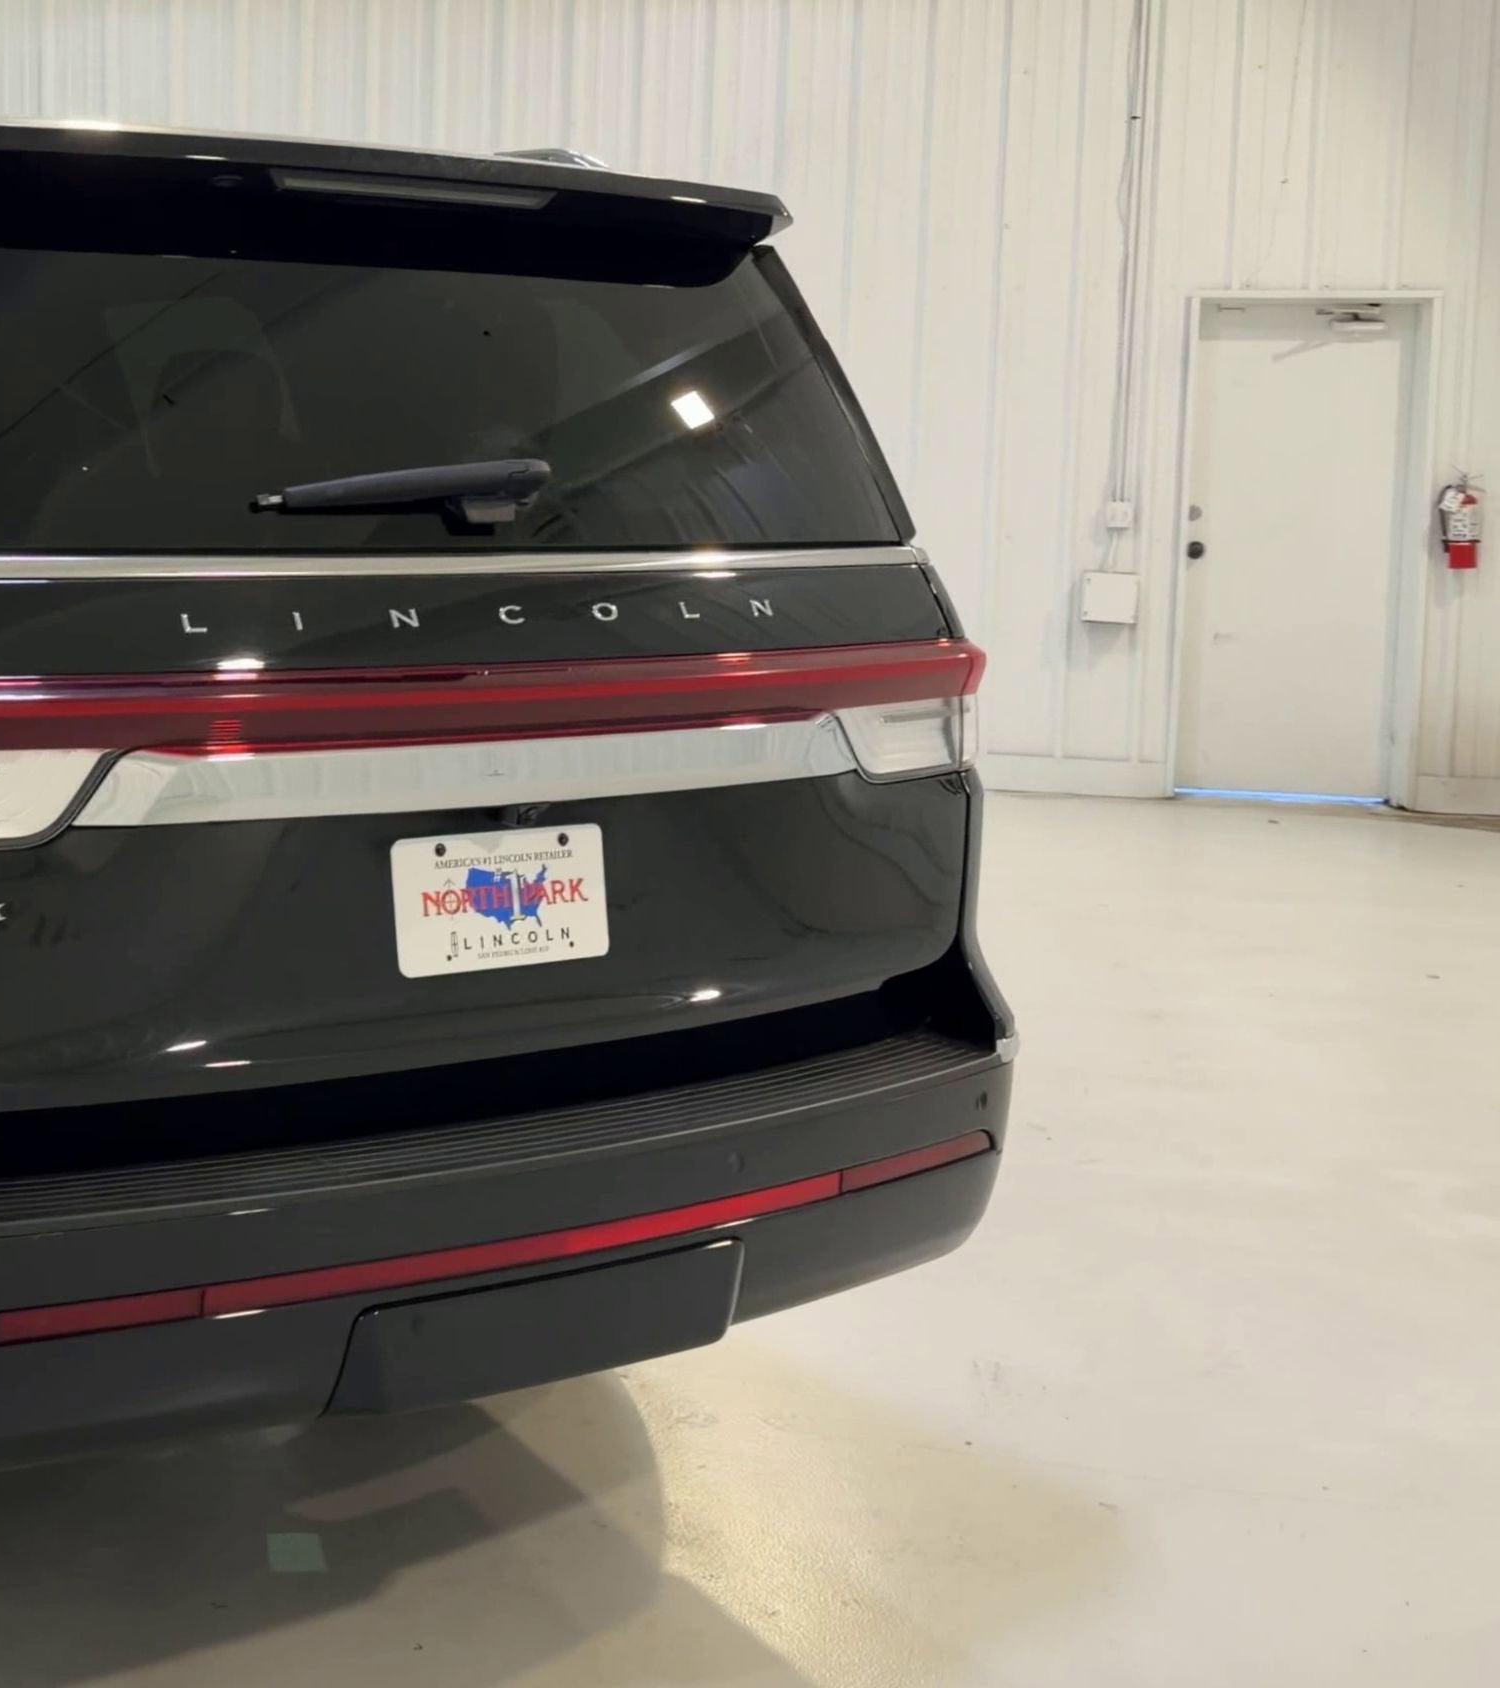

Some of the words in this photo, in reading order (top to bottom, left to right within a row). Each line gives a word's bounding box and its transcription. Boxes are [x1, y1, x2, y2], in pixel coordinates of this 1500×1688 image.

[181, 599, 774, 634] LINCOLN
[434, 856, 481, 869] AMERICA'S
[494, 853, 533, 865] LINCOLN
[534, 849, 573, 862] RETAILER
[421, 884, 511, 917] NORTH
[522, 877, 589, 906] PARK
[463, 927, 570, 950] LINCOLN
